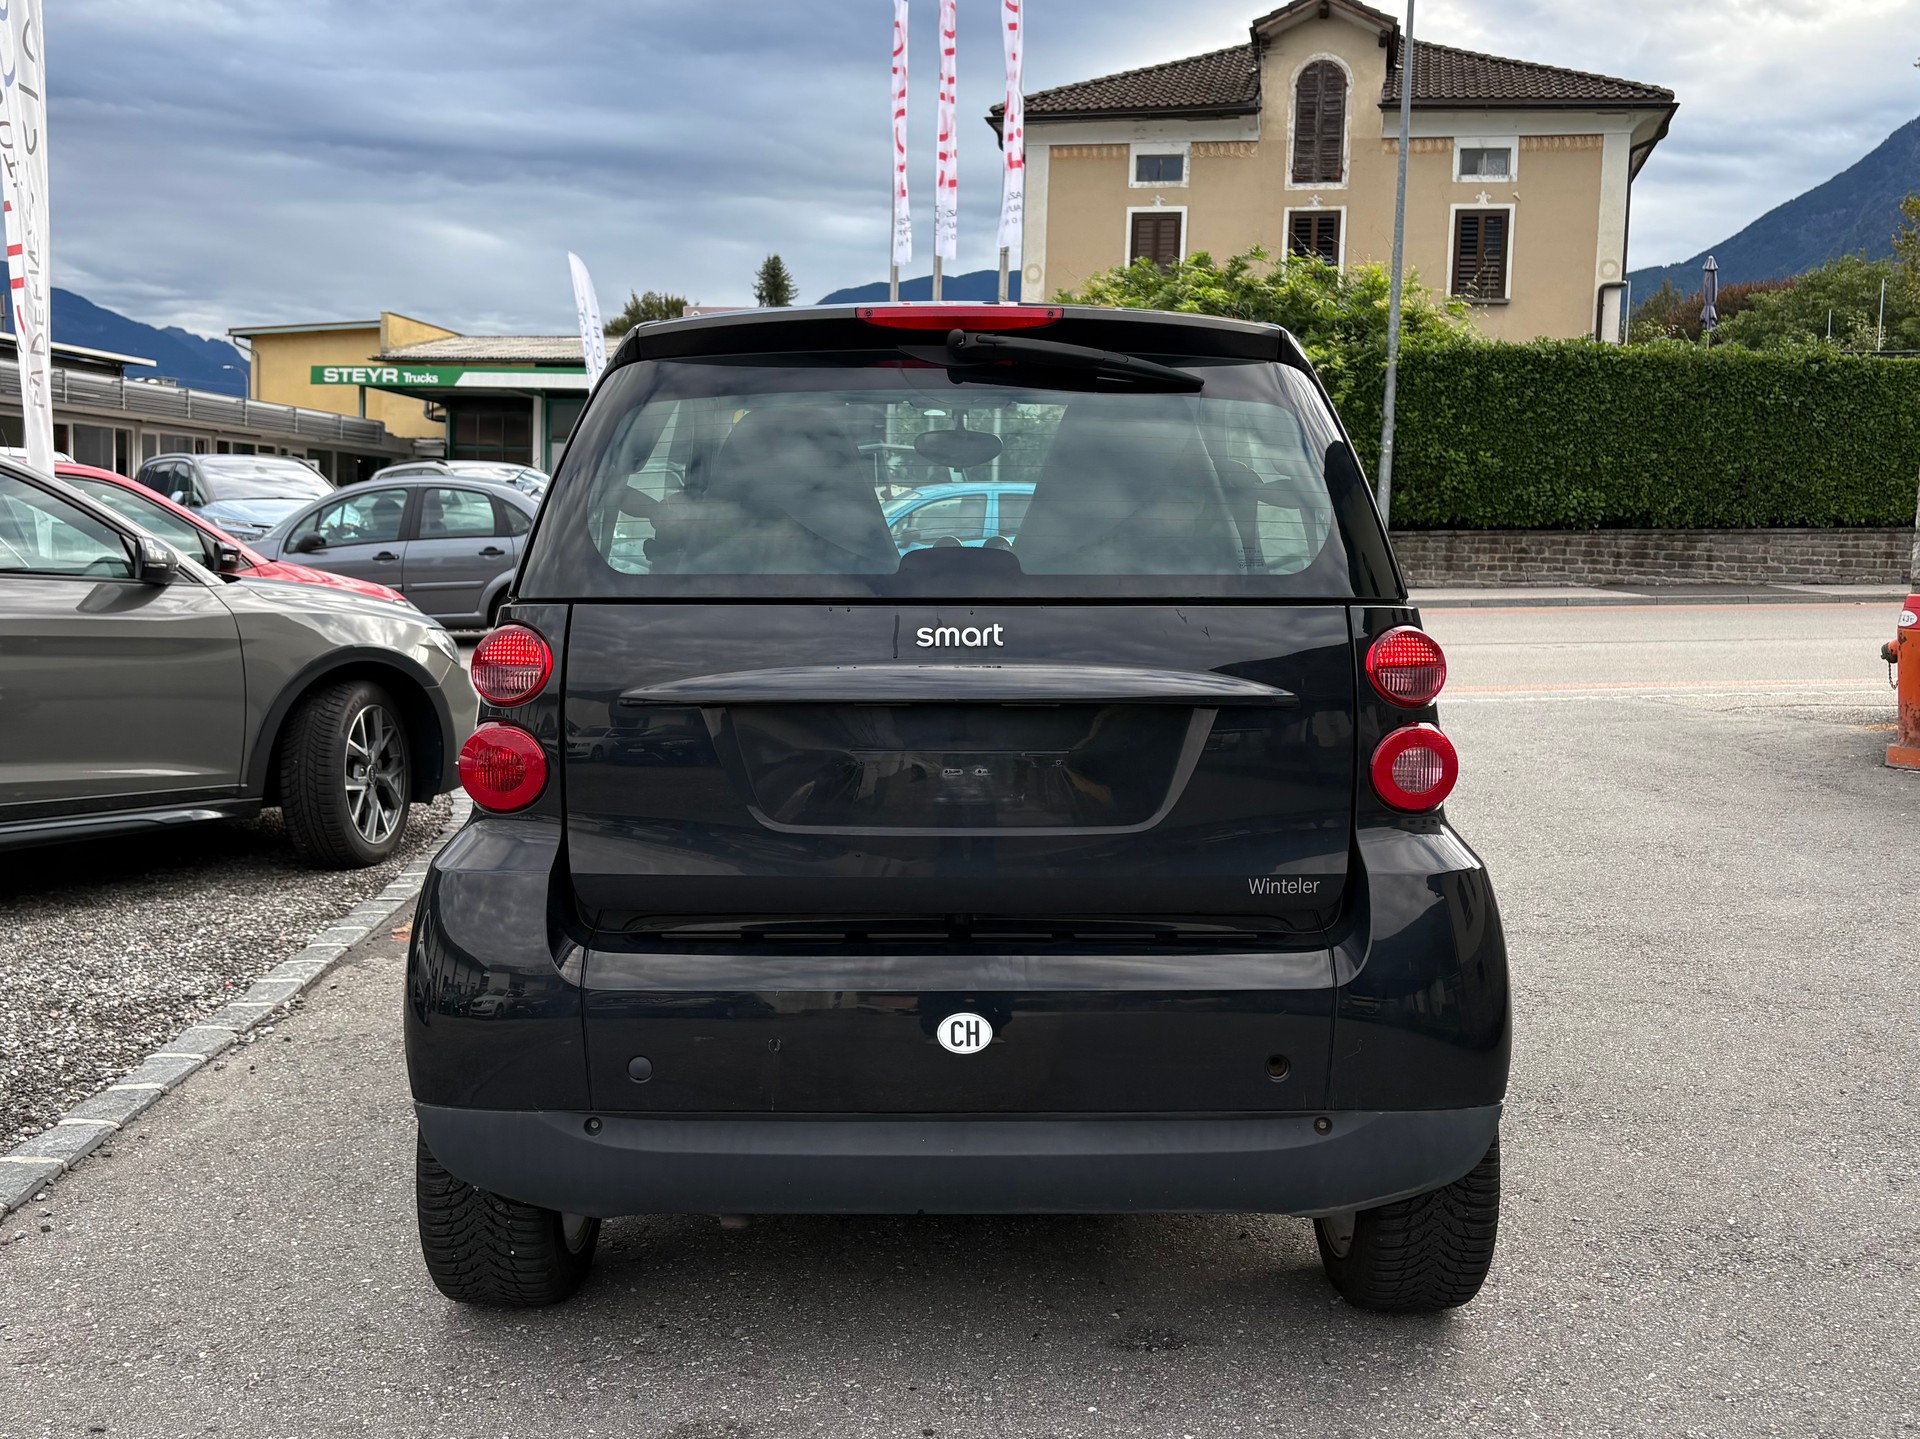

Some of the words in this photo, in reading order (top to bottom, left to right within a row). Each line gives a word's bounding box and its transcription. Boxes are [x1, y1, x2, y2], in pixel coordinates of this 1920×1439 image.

[323, 367, 399, 383] STEYR
[402, 372, 439, 384] Trucks
[916, 623, 1004, 647] smart
[1248, 877, 1321, 895] Winteler
[950, 1020, 980, 1047] CH
